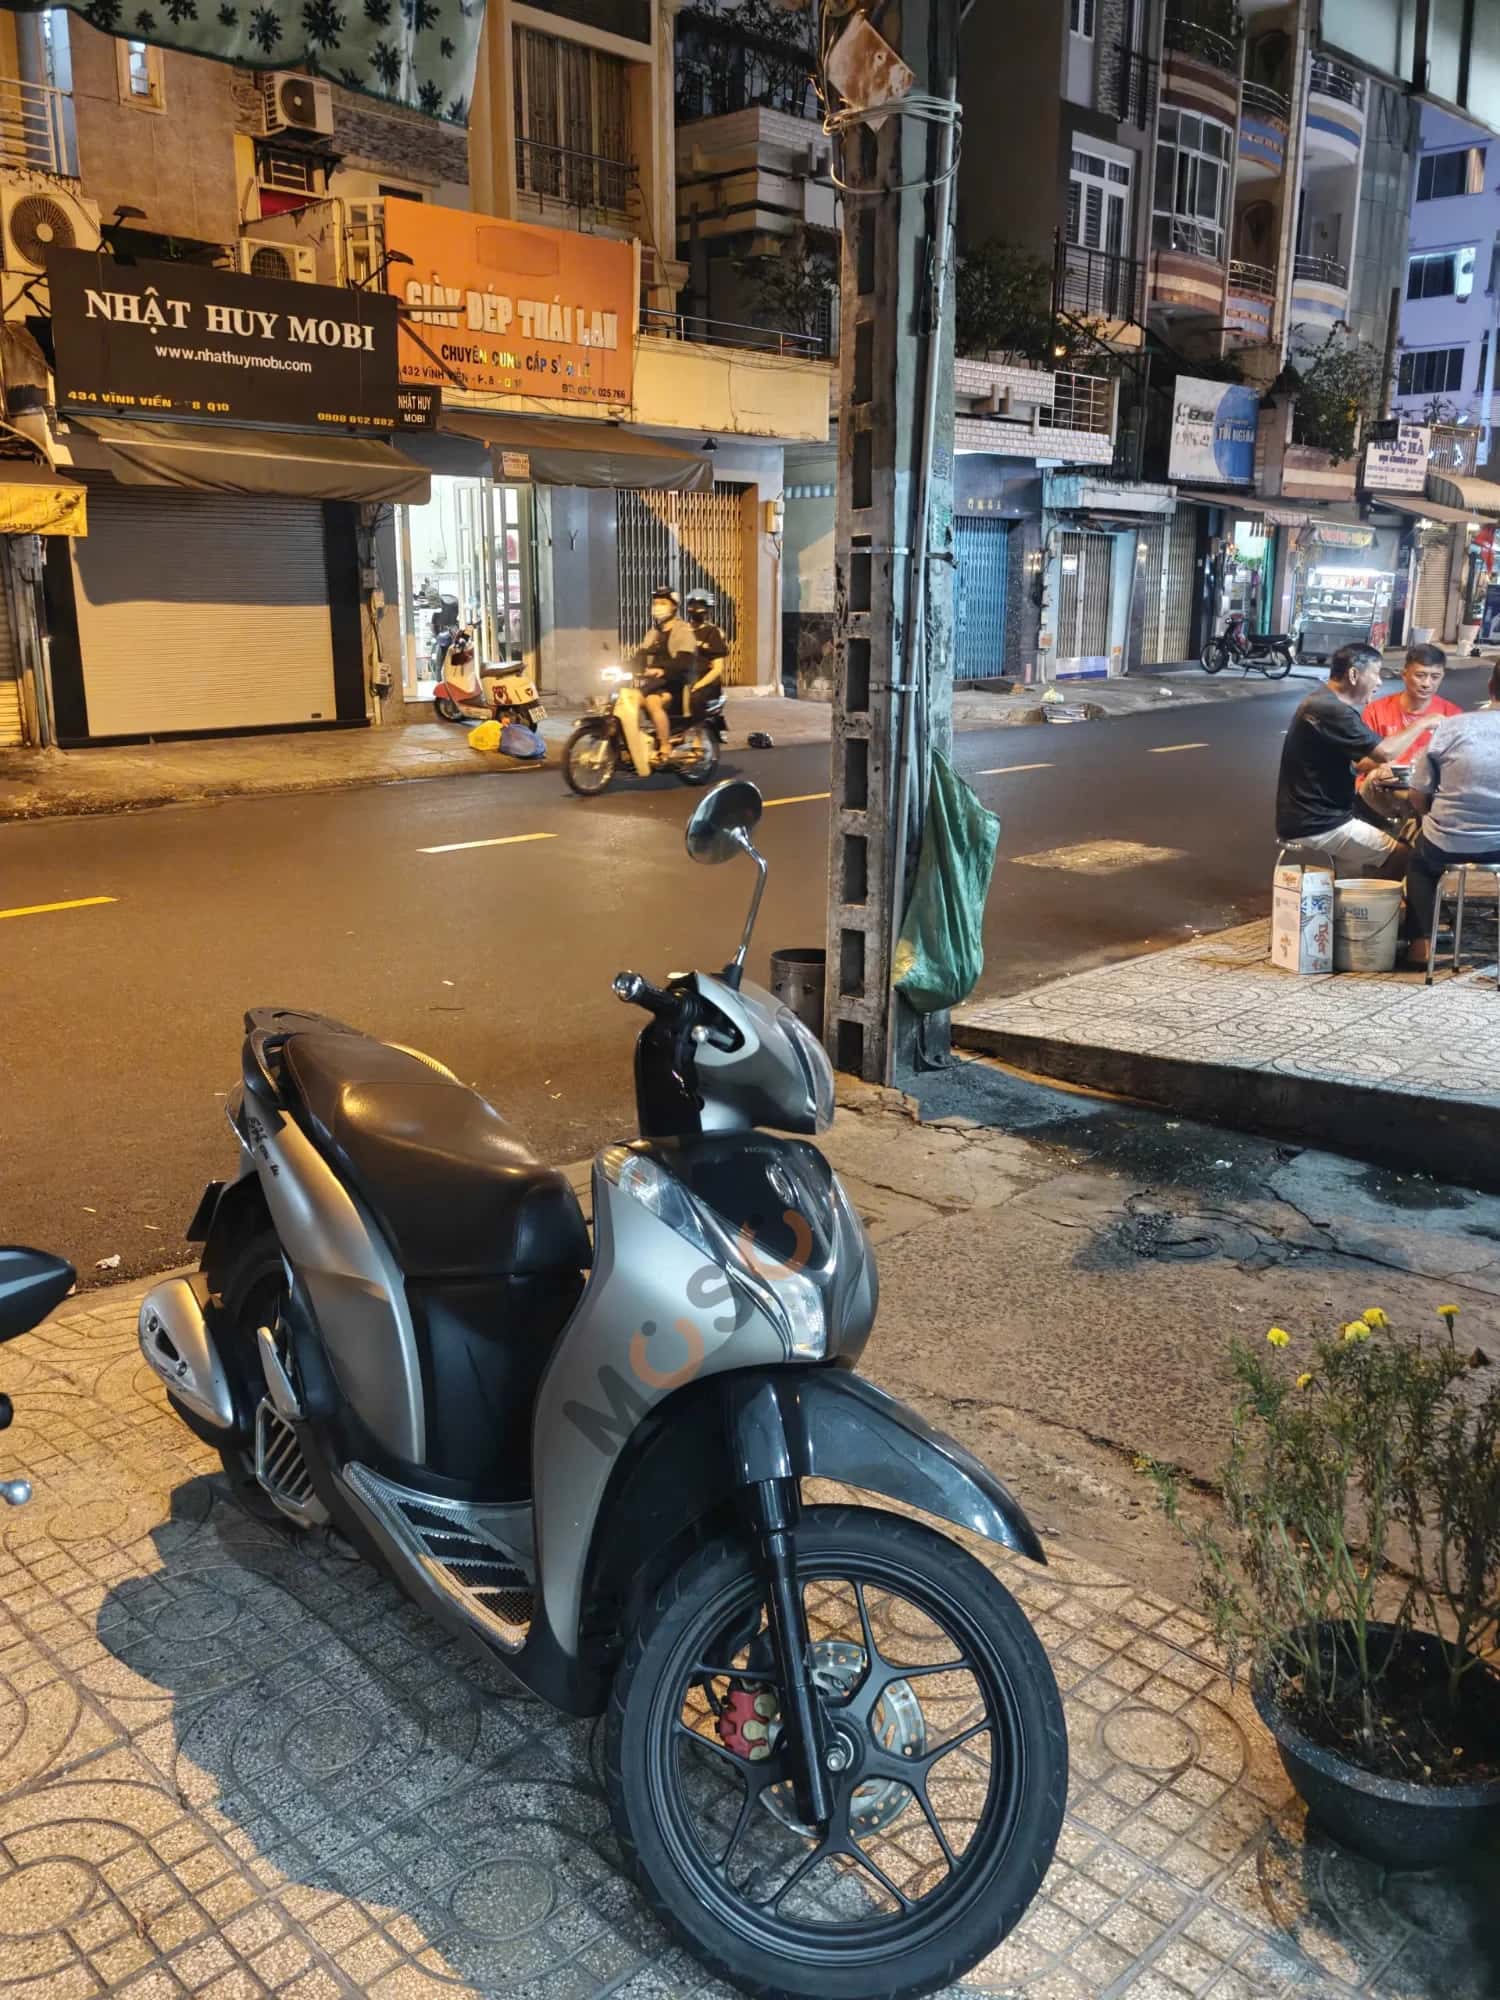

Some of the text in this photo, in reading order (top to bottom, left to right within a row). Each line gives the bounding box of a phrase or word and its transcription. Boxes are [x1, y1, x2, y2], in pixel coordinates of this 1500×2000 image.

[84, 286, 375, 351] NHẬT HUY MOBI
[406, 271, 460, 328] GIÀY
[517, 295, 572, 344] THÁI
[576, 306, 618, 350] LAN
[155, 345, 312, 373] www.nhathuymobi.com
[441, 343, 487, 365] CHUYÊN
[526, 350, 547, 373] CẤP
[401, 365, 420, 377] 432
[67, 390, 97, 402] 434
[398, 393, 432, 411] NHẬT HUY
[404, 413, 426, 424] MOBI
